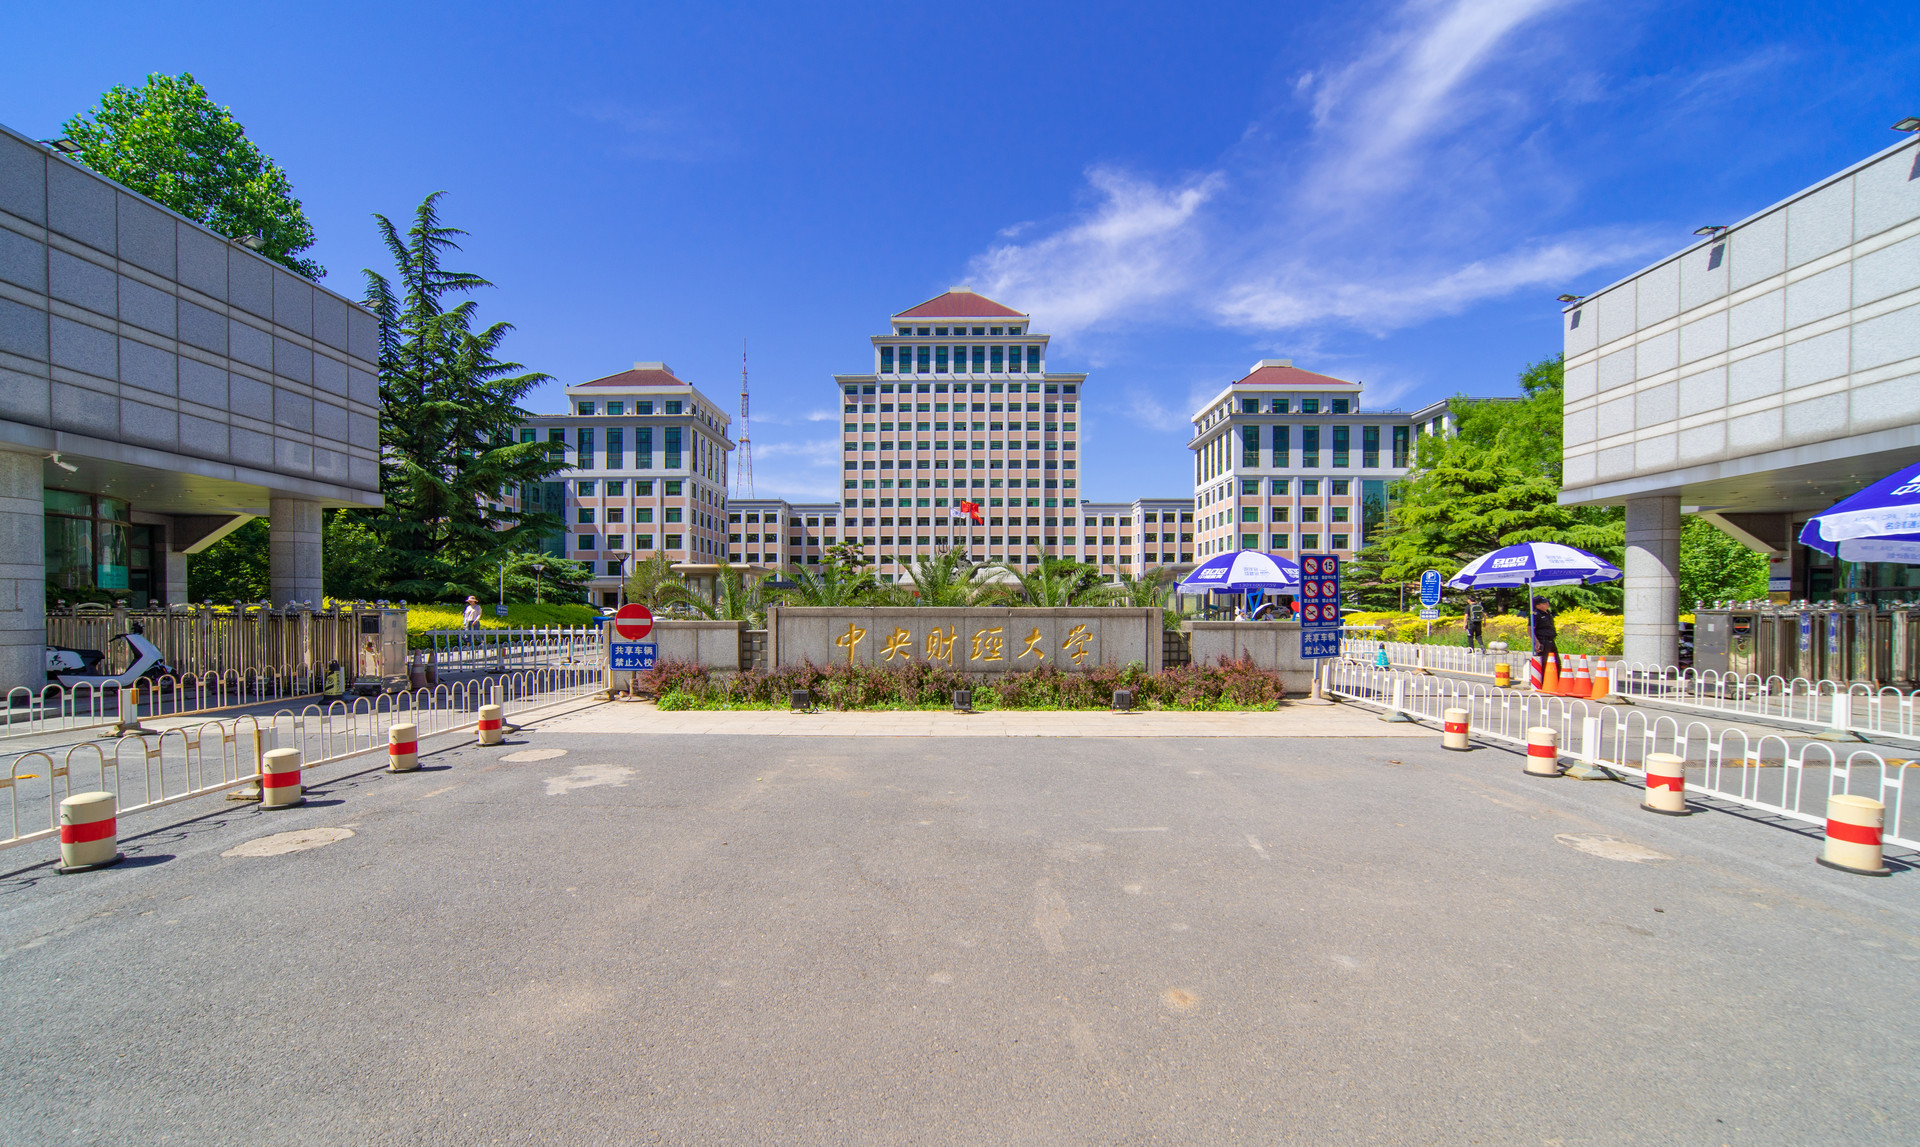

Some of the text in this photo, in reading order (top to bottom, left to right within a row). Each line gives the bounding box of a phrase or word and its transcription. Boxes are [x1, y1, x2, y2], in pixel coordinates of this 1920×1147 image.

[1324, 561, 1334, 571] 15
[1304, 632, 1336, 643] 共享车辆
[615, 645, 653, 656] 共享车辆
[1304, 645, 1336, 656] 禁止入校
[615, 657, 653, 668] 禁止入校
